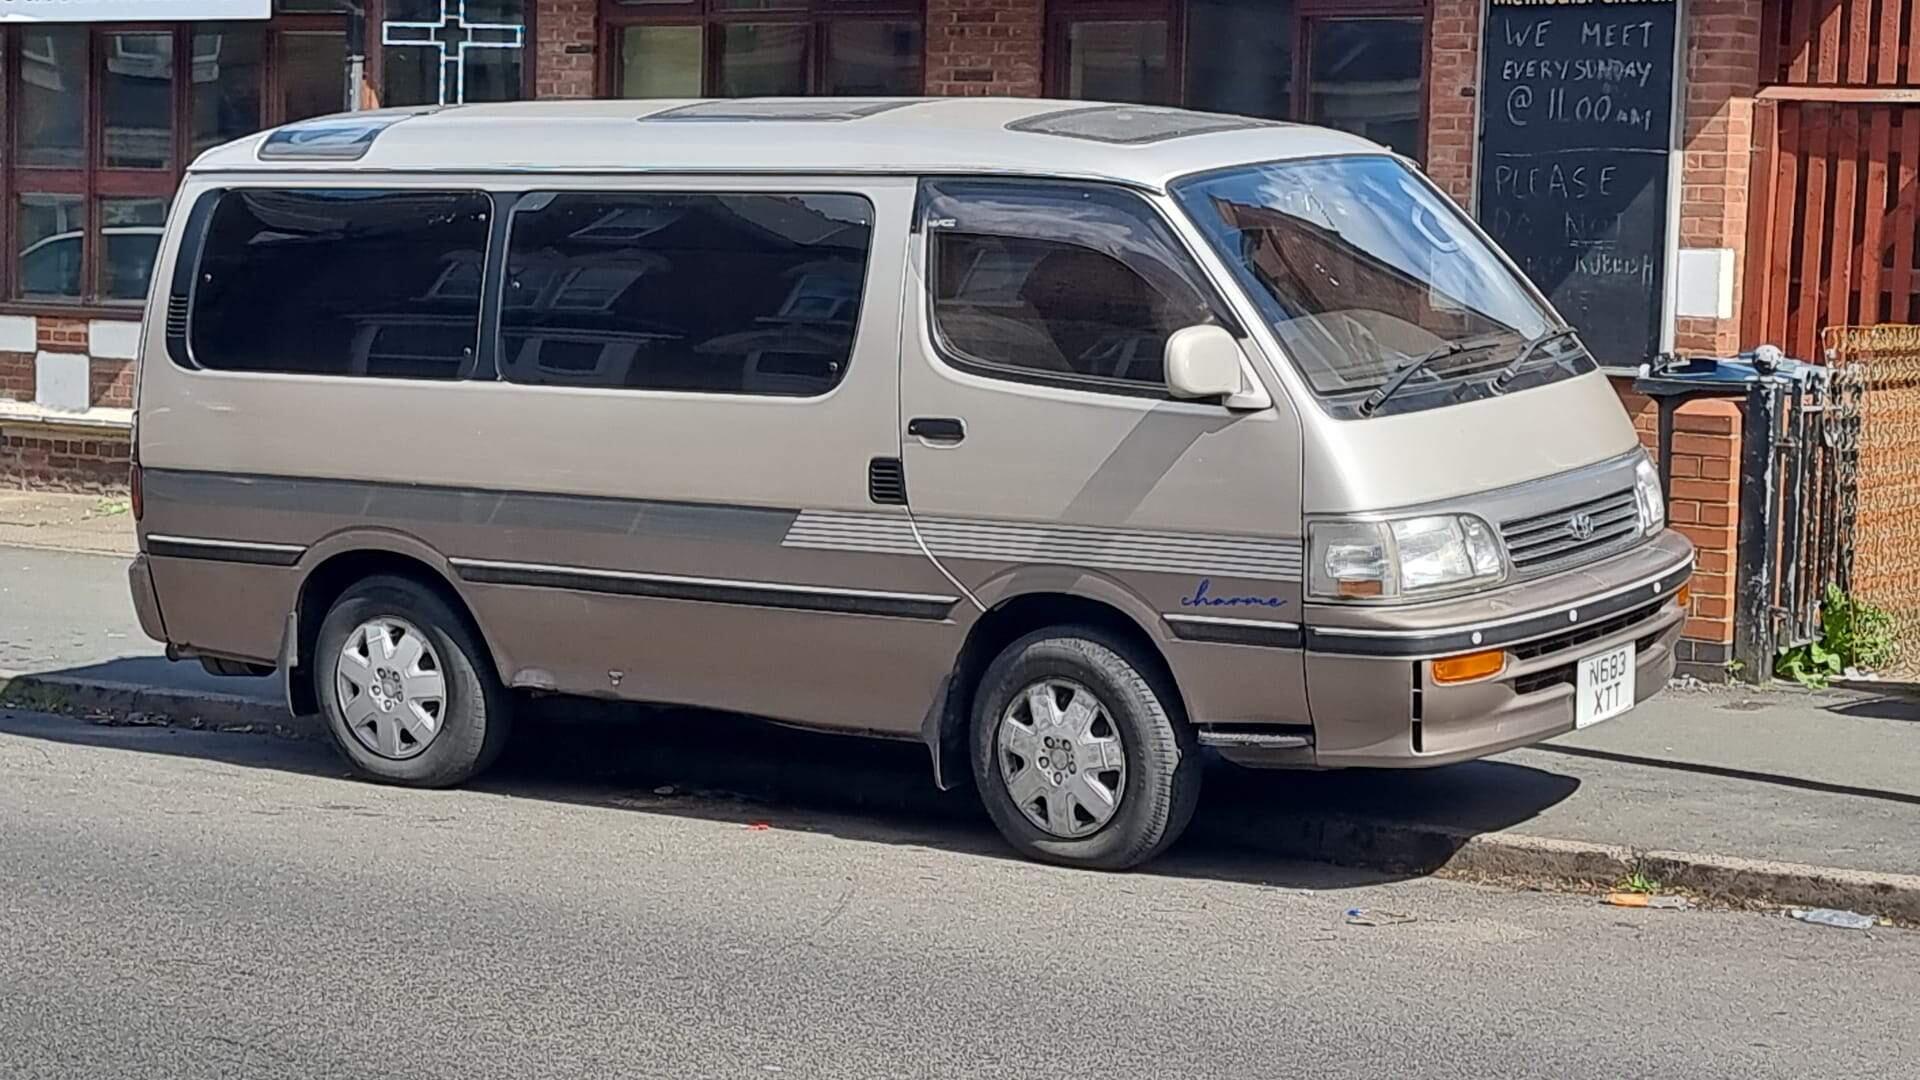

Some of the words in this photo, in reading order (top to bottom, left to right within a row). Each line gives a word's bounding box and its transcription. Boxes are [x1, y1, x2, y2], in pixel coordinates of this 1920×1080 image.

[1505, 18, 1551, 48] WE
[1580, 20, 1653, 48] MEET
[1502, 59, 1568, 80] EVERY
[1573, 58, 1652, 87] SUNDAY
[1495, 163, 1617, 199] PLEASE
[1590, 650, 1626, 688] N683
[1594, 681, 1621, 715] XTT
